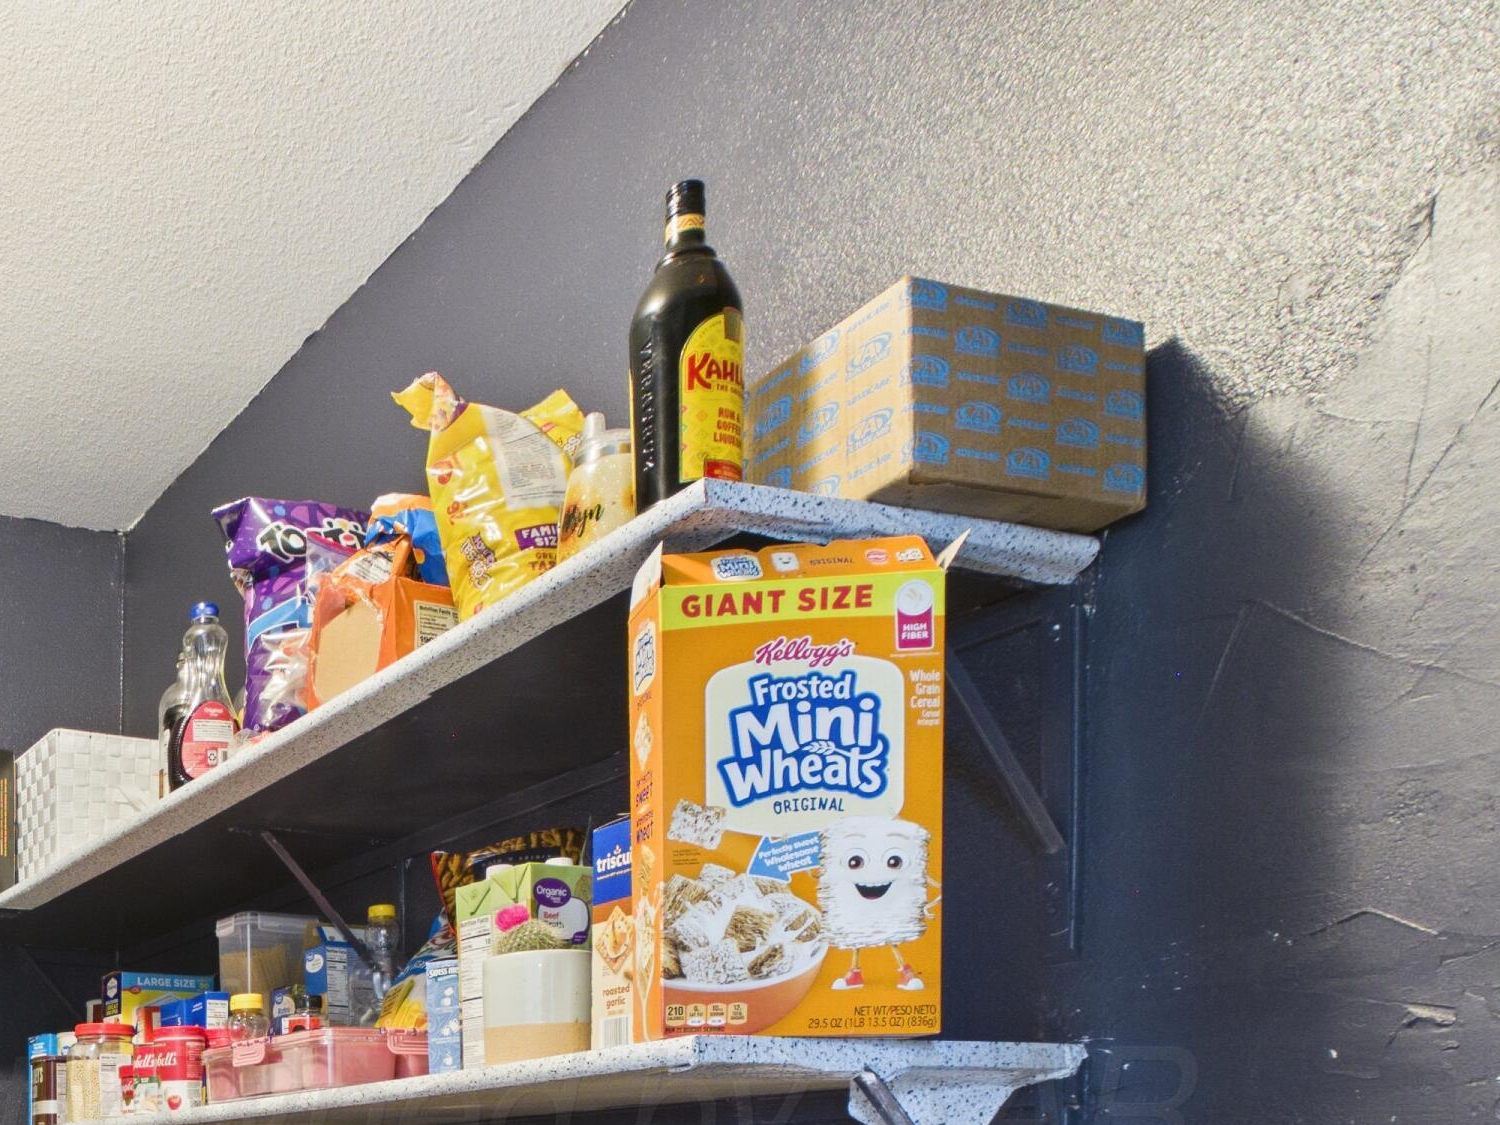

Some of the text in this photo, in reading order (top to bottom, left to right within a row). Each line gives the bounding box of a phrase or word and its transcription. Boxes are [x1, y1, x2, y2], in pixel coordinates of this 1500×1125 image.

[686, 352, 744, 391] KAHL
[522, 525, 557, 539] FAMI
[535, 537, 557, 547] SIZ
[681, 584, 874, 618] GIANT SIZE
[902, 622, 929, 633] HIGH
[901, 631, 929, 640] FIBER
[755, 637, 852, 667] Kellogg's
[909, 669, 940, 682] Whole
[754, 673, 853, 706] Frosted
[737, 698, 875, 759] Mini
[724, 744, 884, 801] Wheats
[772, 800, 845, 815] ORIGINAL
[536, 884, 568, 898] Organic
[137, 977, 197, 988] LARGE SIZE
[668, 1006, 684, 1016] 210
[854, 1004, 937, 1016] NET WT/PESO NETO
[808, 1017, 829, 1029] 29.5
[832, 1017, 843, 1028] OZ
[868, 1016, 888, 1028] 13.5
